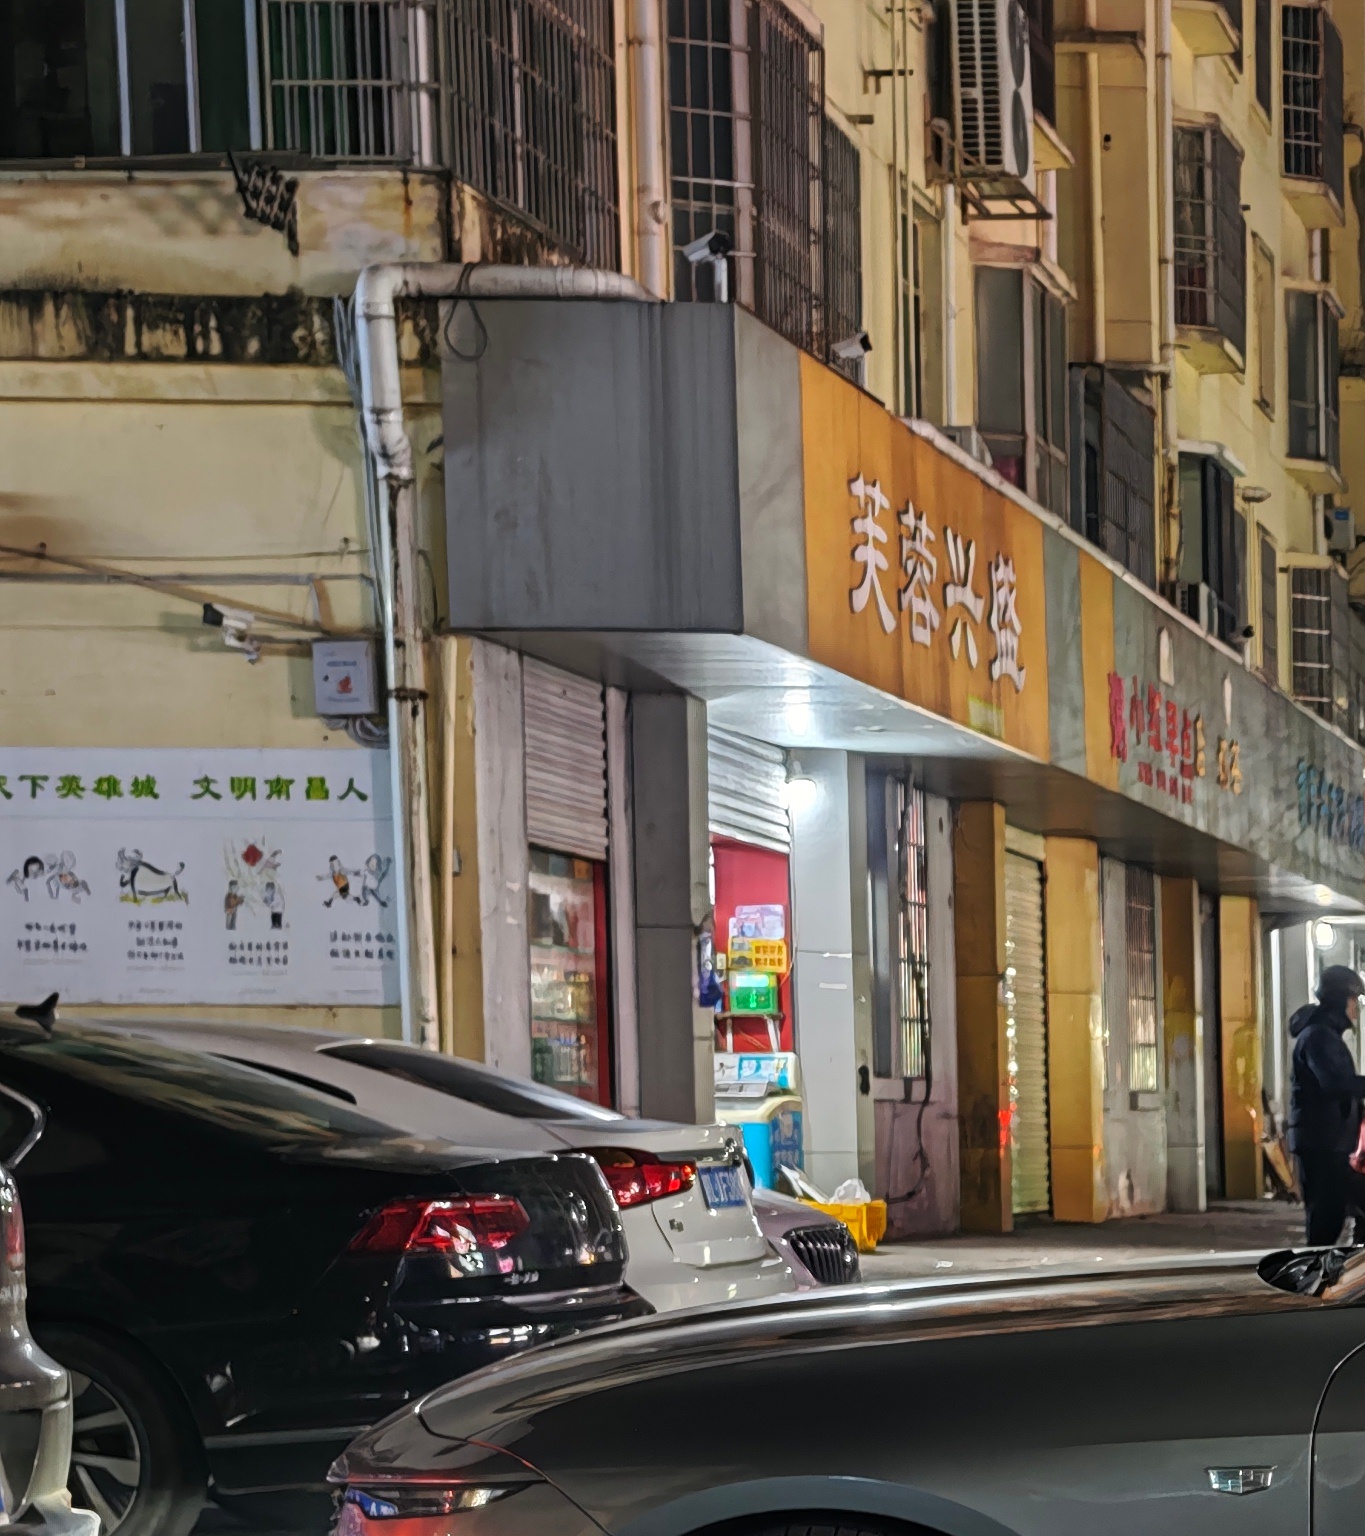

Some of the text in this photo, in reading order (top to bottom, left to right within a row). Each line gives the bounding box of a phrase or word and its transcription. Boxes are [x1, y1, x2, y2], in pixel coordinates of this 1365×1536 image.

[848, 471, 1026, 694] 芙蓉兴盛
[190, 774, 369, 801] 文明南昌人
